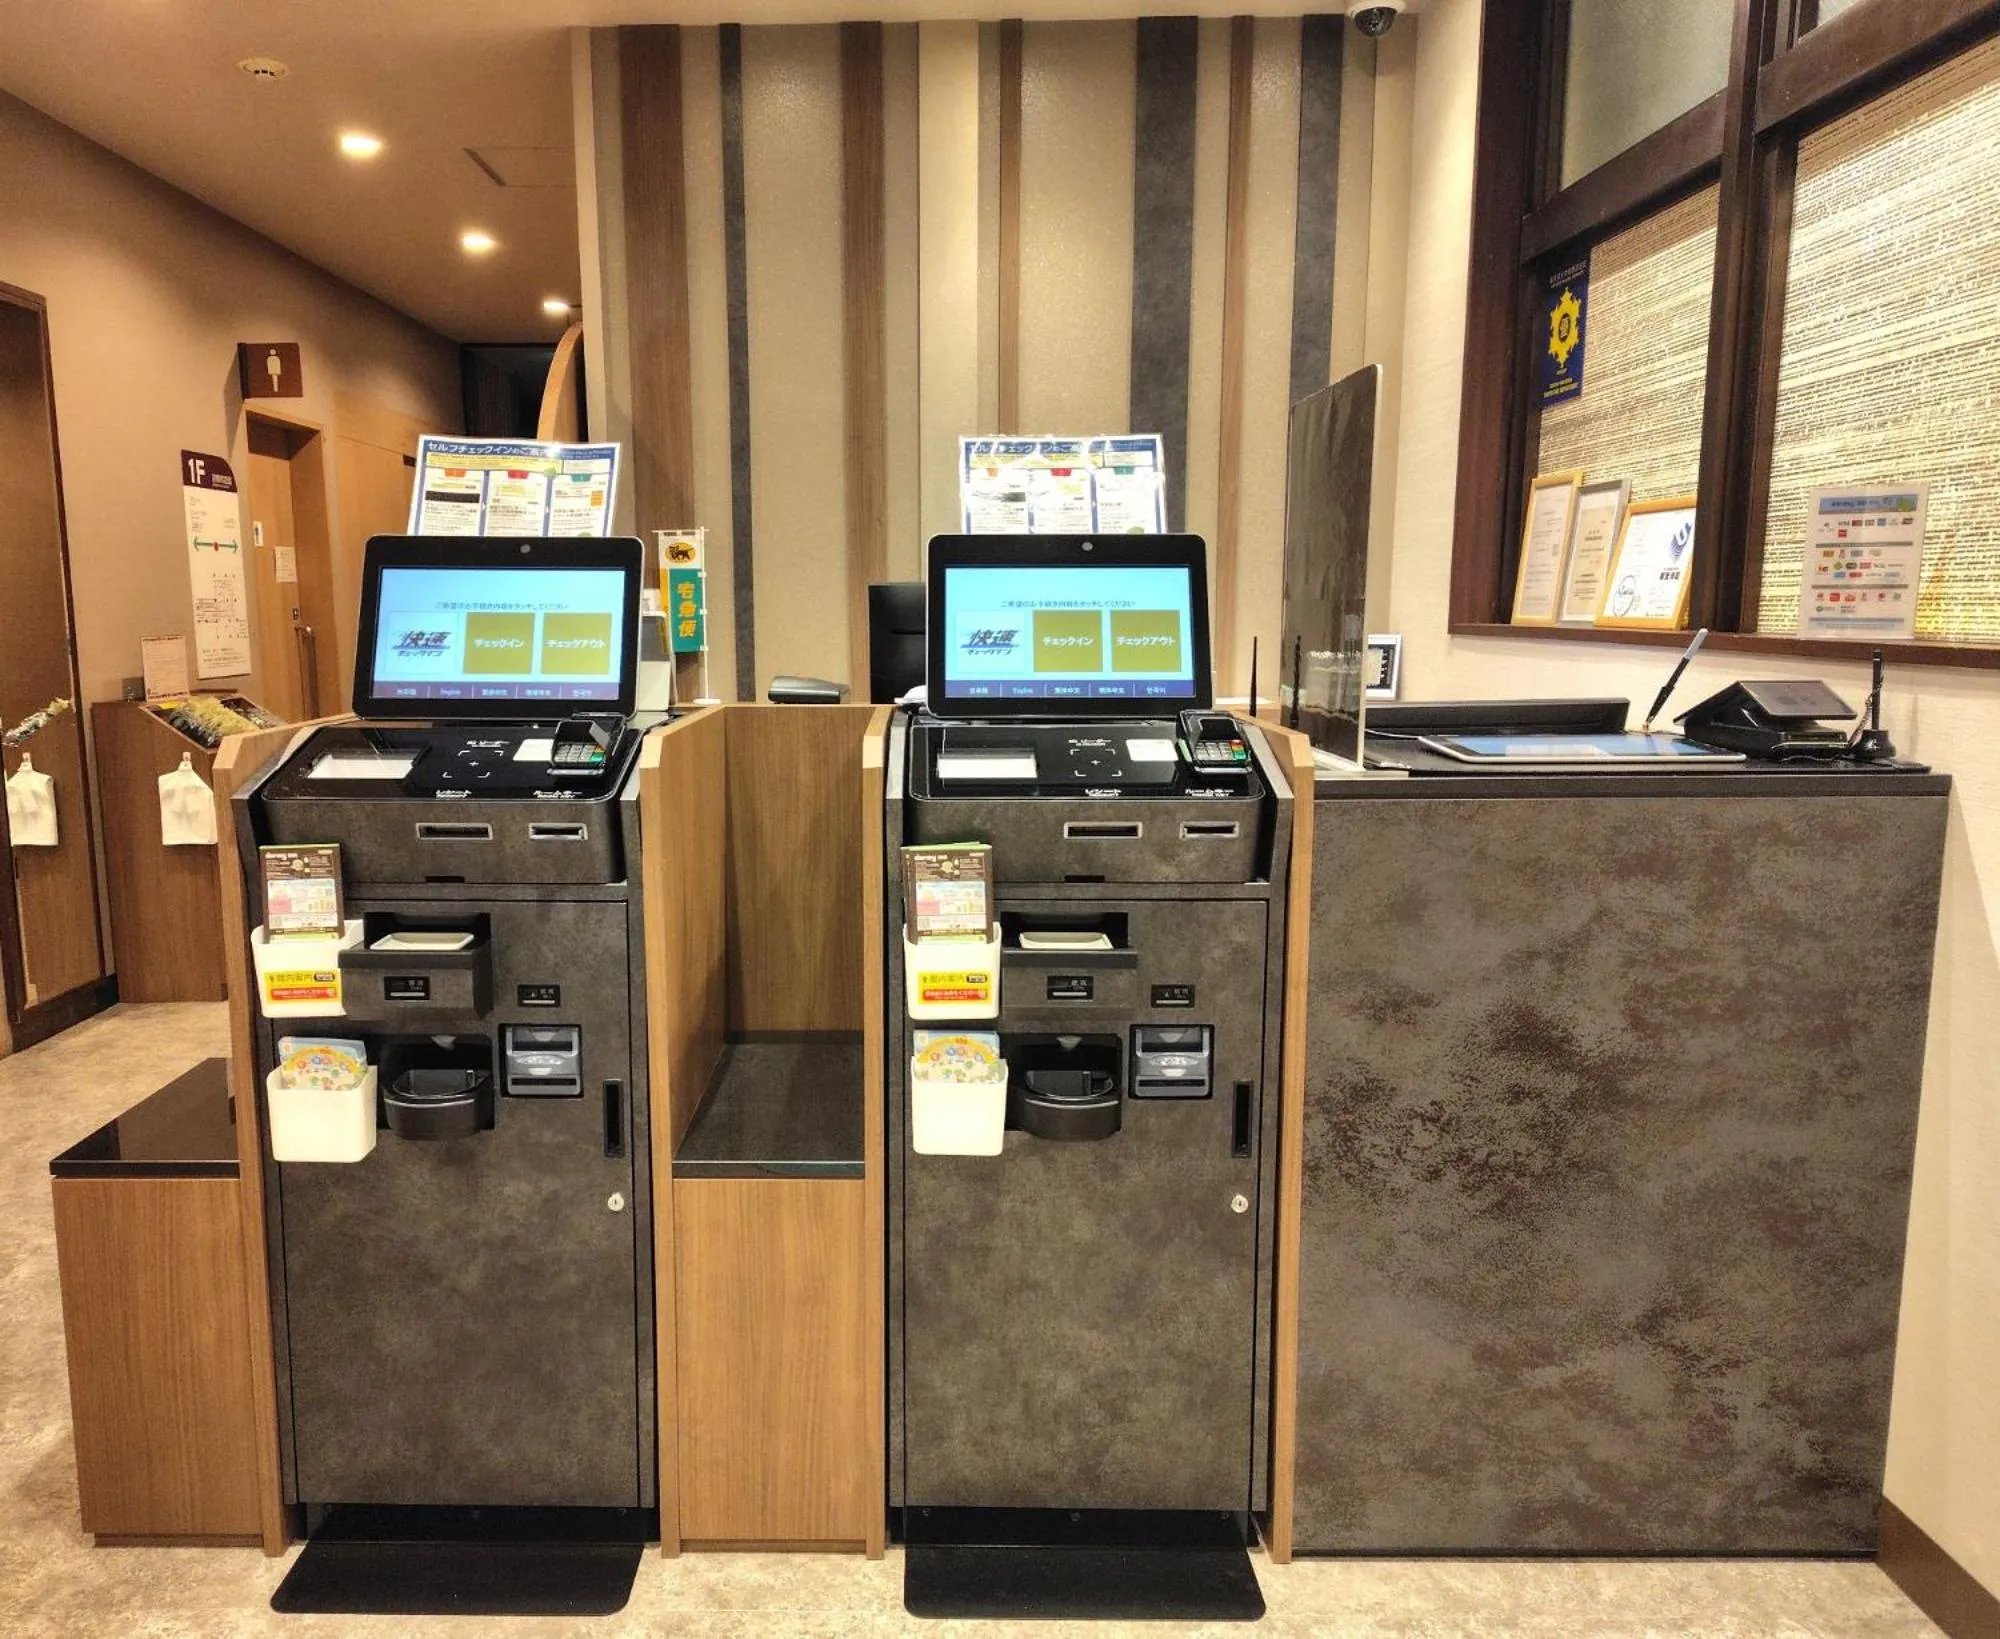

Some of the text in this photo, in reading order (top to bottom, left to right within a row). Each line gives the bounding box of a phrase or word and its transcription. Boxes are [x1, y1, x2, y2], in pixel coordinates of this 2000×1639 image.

[188, 458, 205, 484] 1F
[473, 639, 525, 649] チェックイン
[545, 639, 606, 649] チェックアウト
[1043, 636, 1093, 647] チェックイン
[1116, 635, 1175, 646] チェックアウト
